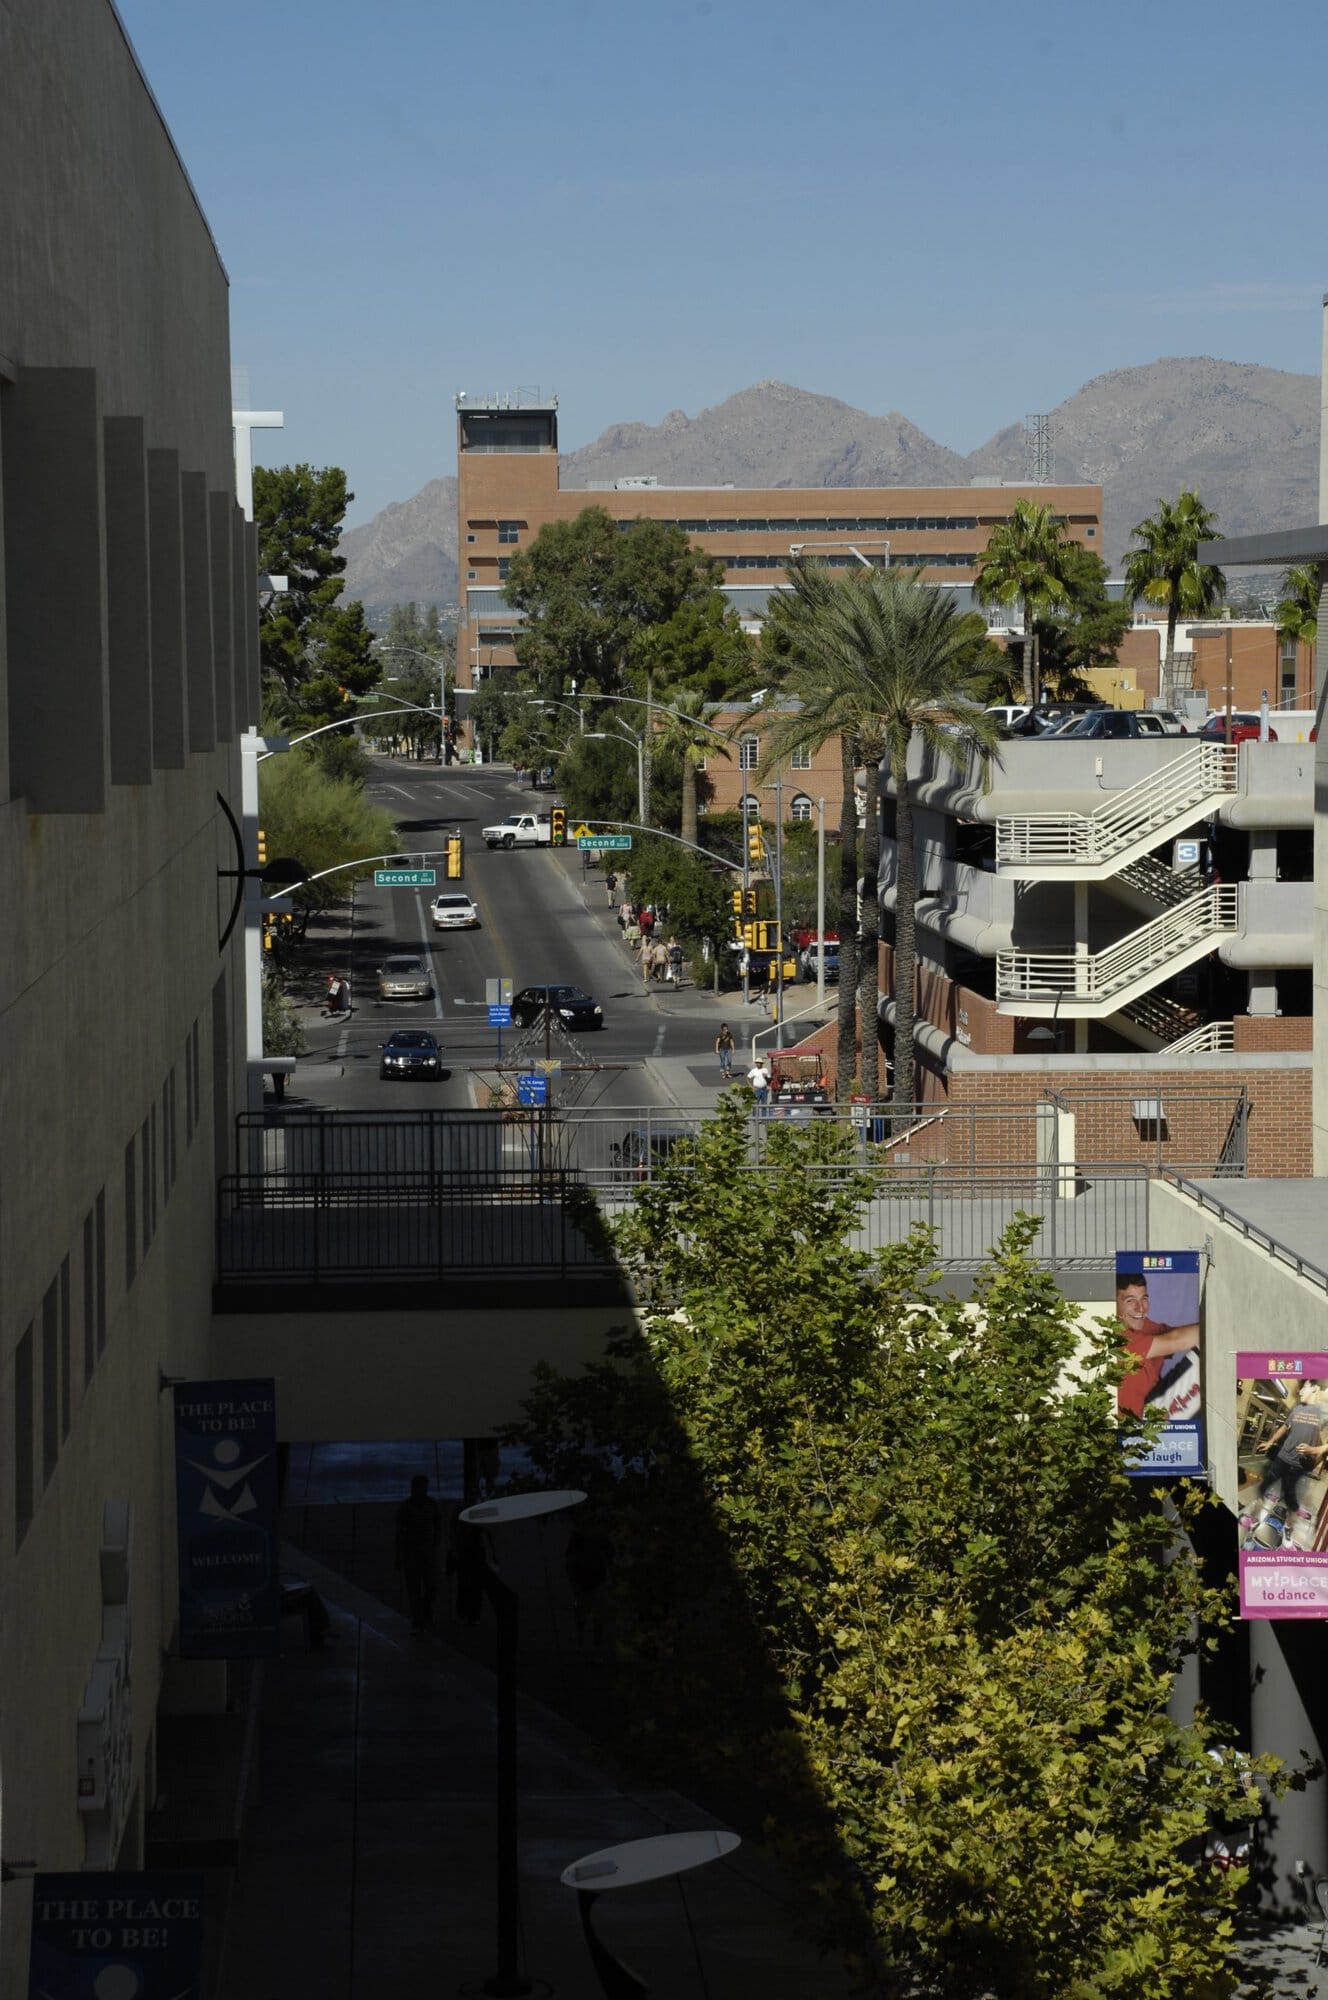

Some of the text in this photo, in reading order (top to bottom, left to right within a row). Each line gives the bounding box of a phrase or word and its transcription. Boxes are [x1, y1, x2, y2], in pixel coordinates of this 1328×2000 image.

[581, 839, 615, 847] Second
[1180, 845, 1196, 860] 3
[378, 873, 418, 882] Second
[176, 1399, 273, 1417] THE PLACE
[197, 1416, 257, 1433] TO BE!
[1152, 1451, 1182, 1464] laugh
[191, 1552, 265, 1568] WELCOME
[1305, 1556, 1328, 1564] UNION
[1262, 1588, 1316, 1601] to dance
[37, 1898, 199, 1921] THE PLACE
[71, 1927, 169, 1949] TO BE!
